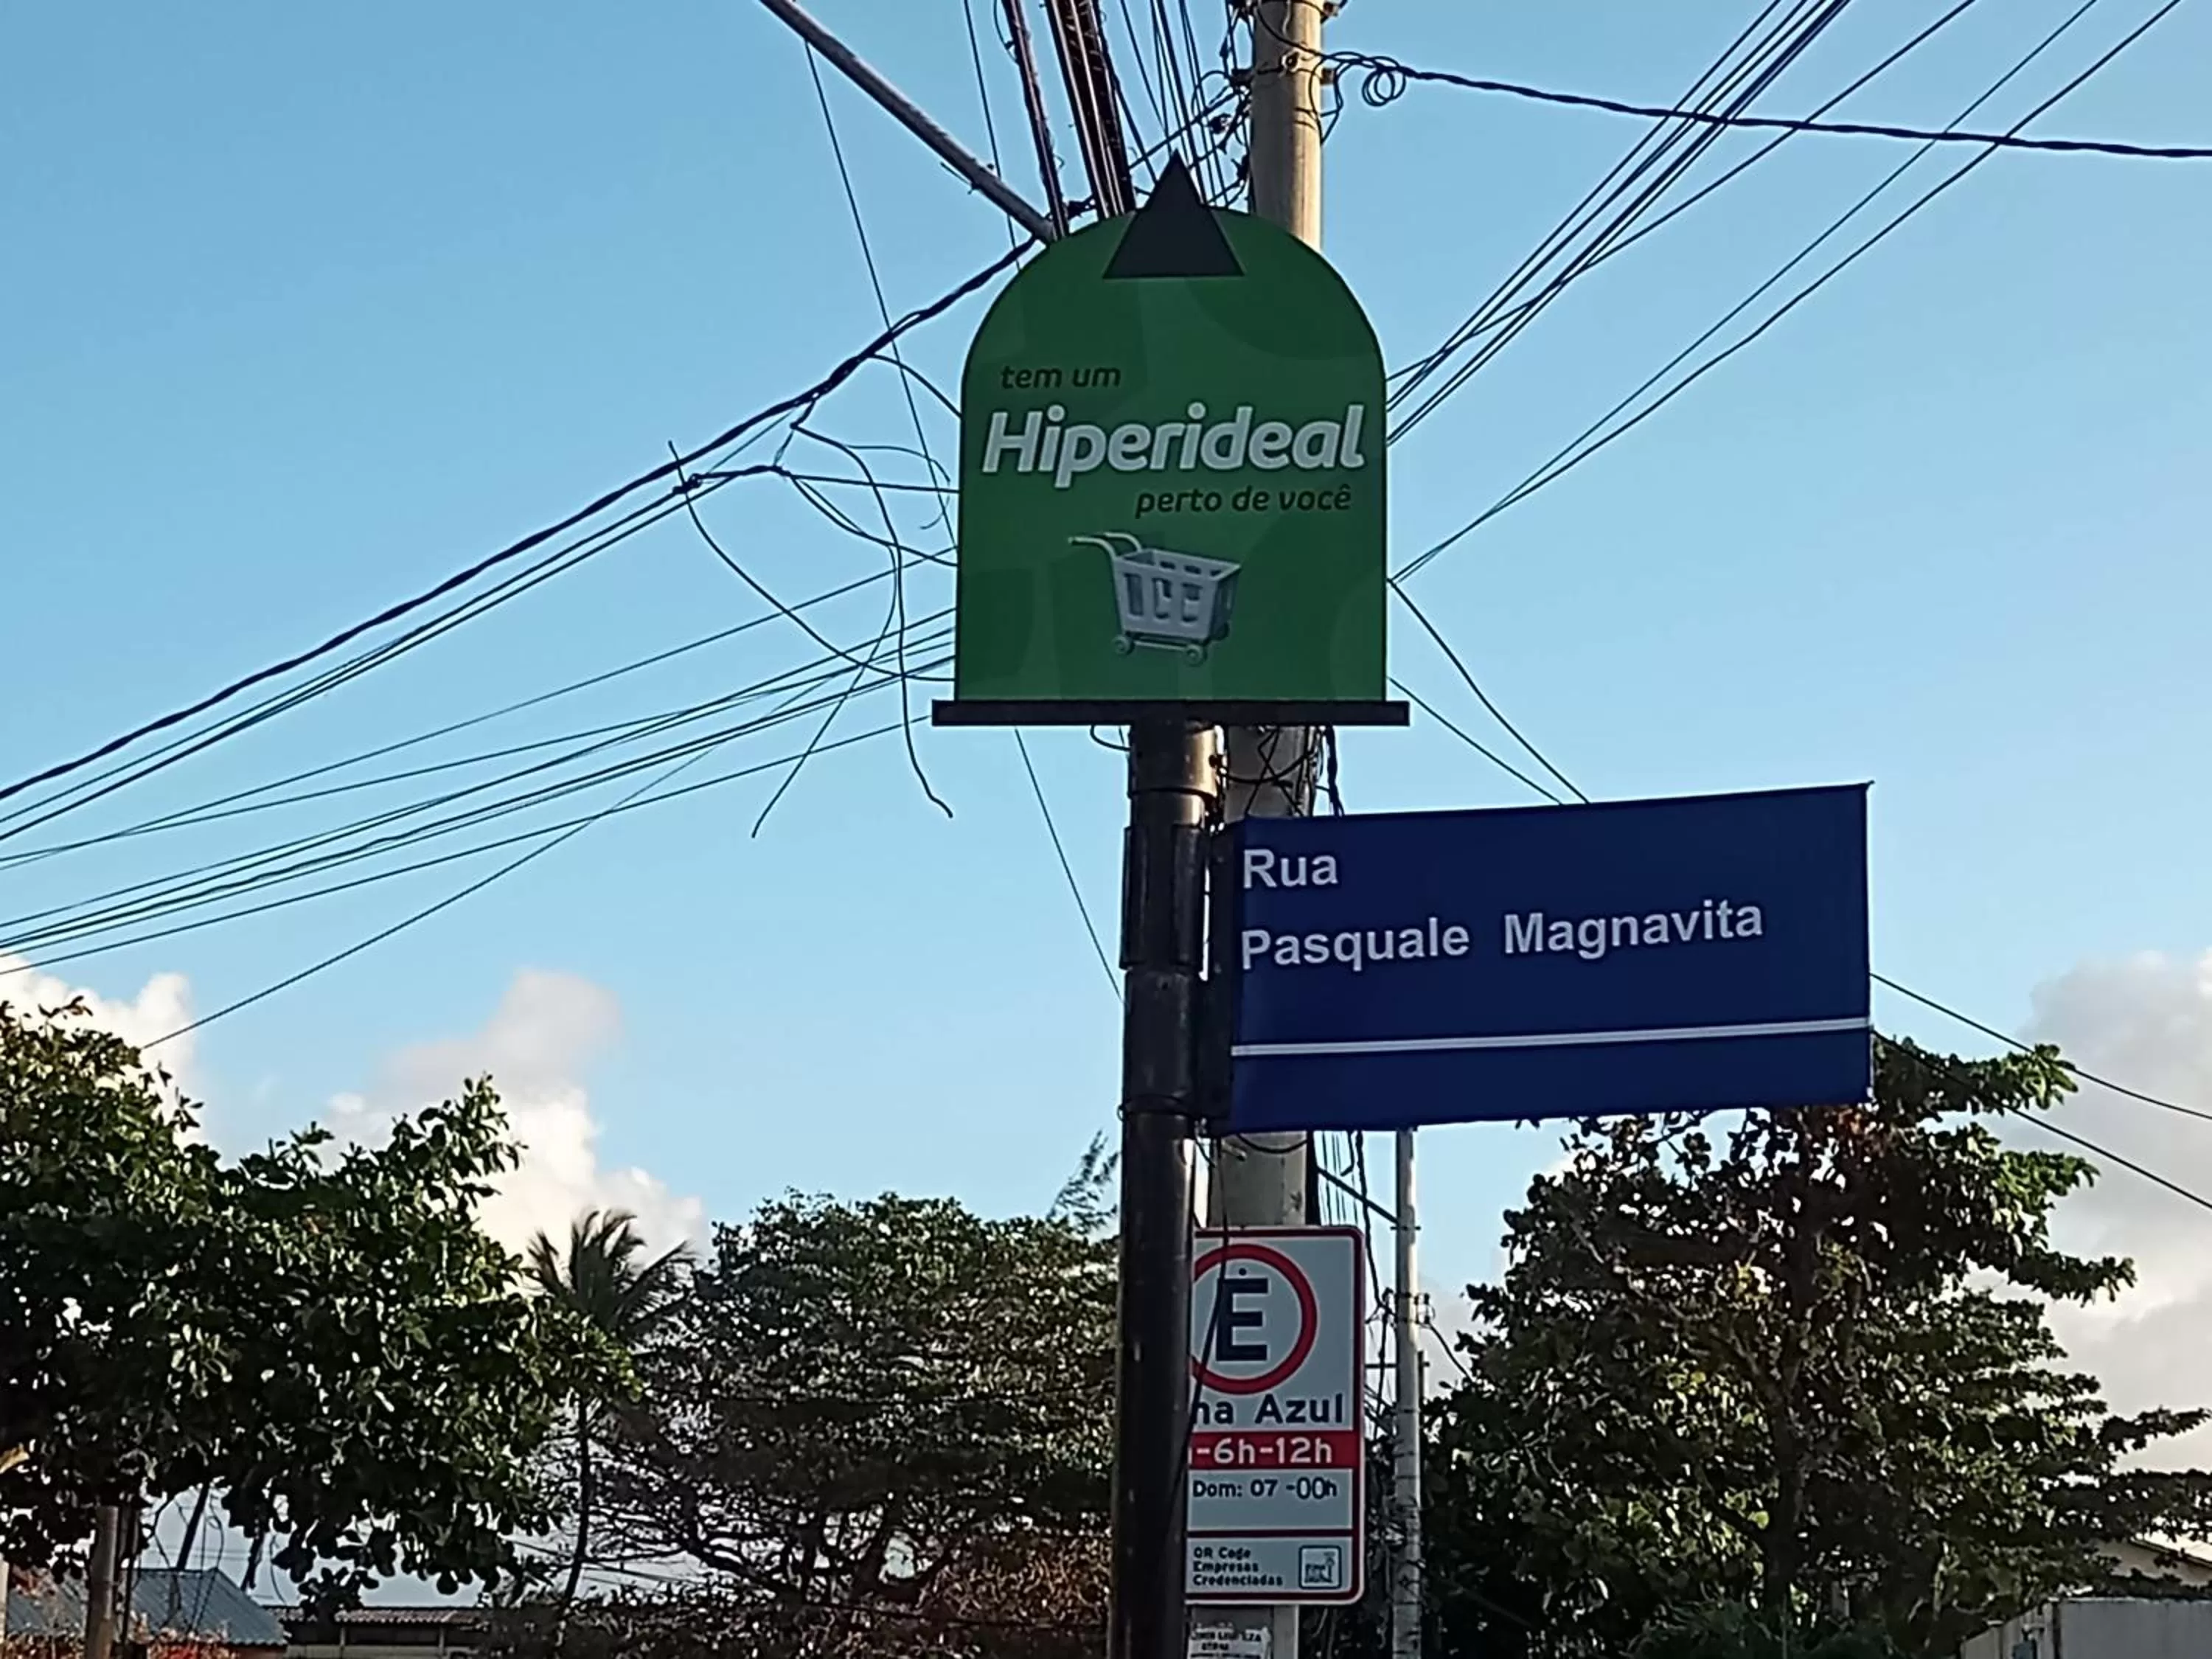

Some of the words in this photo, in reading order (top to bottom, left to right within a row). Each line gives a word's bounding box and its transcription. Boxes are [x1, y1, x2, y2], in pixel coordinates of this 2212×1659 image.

[1001, 365, 1062, 389] tem
[1072, 367, 1121, 388] um
[981, 402, 1366, 489] Hiperideal
[1135, 487, 1222, 519] perto
[1231, 485, 1270, 511] de
[1279, 483, 1352, 511] você
[1242, 849, 1339, 888] Rua
[1242, 917, 1470, 971] Pasquale
[1504, 899, 1764, 959] Magnavita
[1216, 1278, 1268, 1361] E
[1254, 1393, 1343, 1424] Azul
[1192, 1480, 1242, 1498] Dom:
[1251, 1479, 1279, 1496] 07
